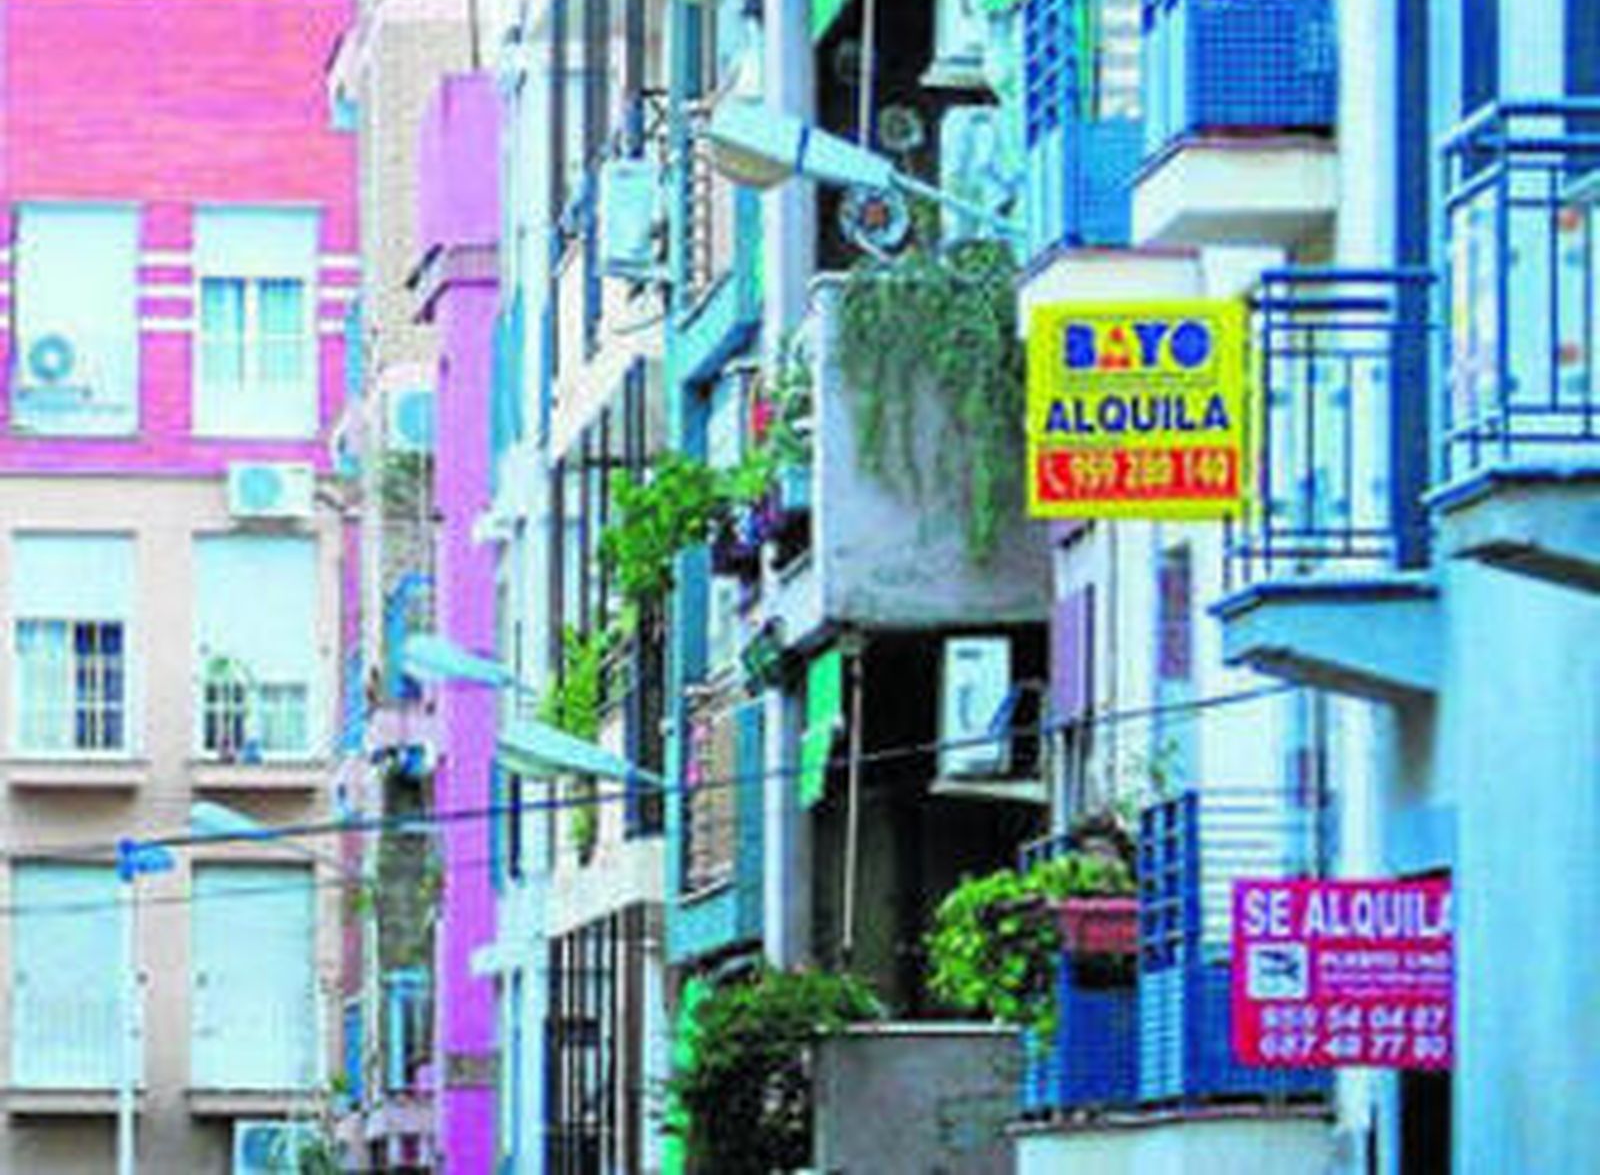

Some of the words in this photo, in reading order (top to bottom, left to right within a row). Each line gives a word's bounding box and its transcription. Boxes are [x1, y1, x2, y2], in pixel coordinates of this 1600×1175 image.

[1065, 321, 1210, 369] BAYO
[1046, 392, 1230, 432] ALQUILA
[1243, 888, 1292, 937] SE
[1369, 1034, 1406, 1059] 77
